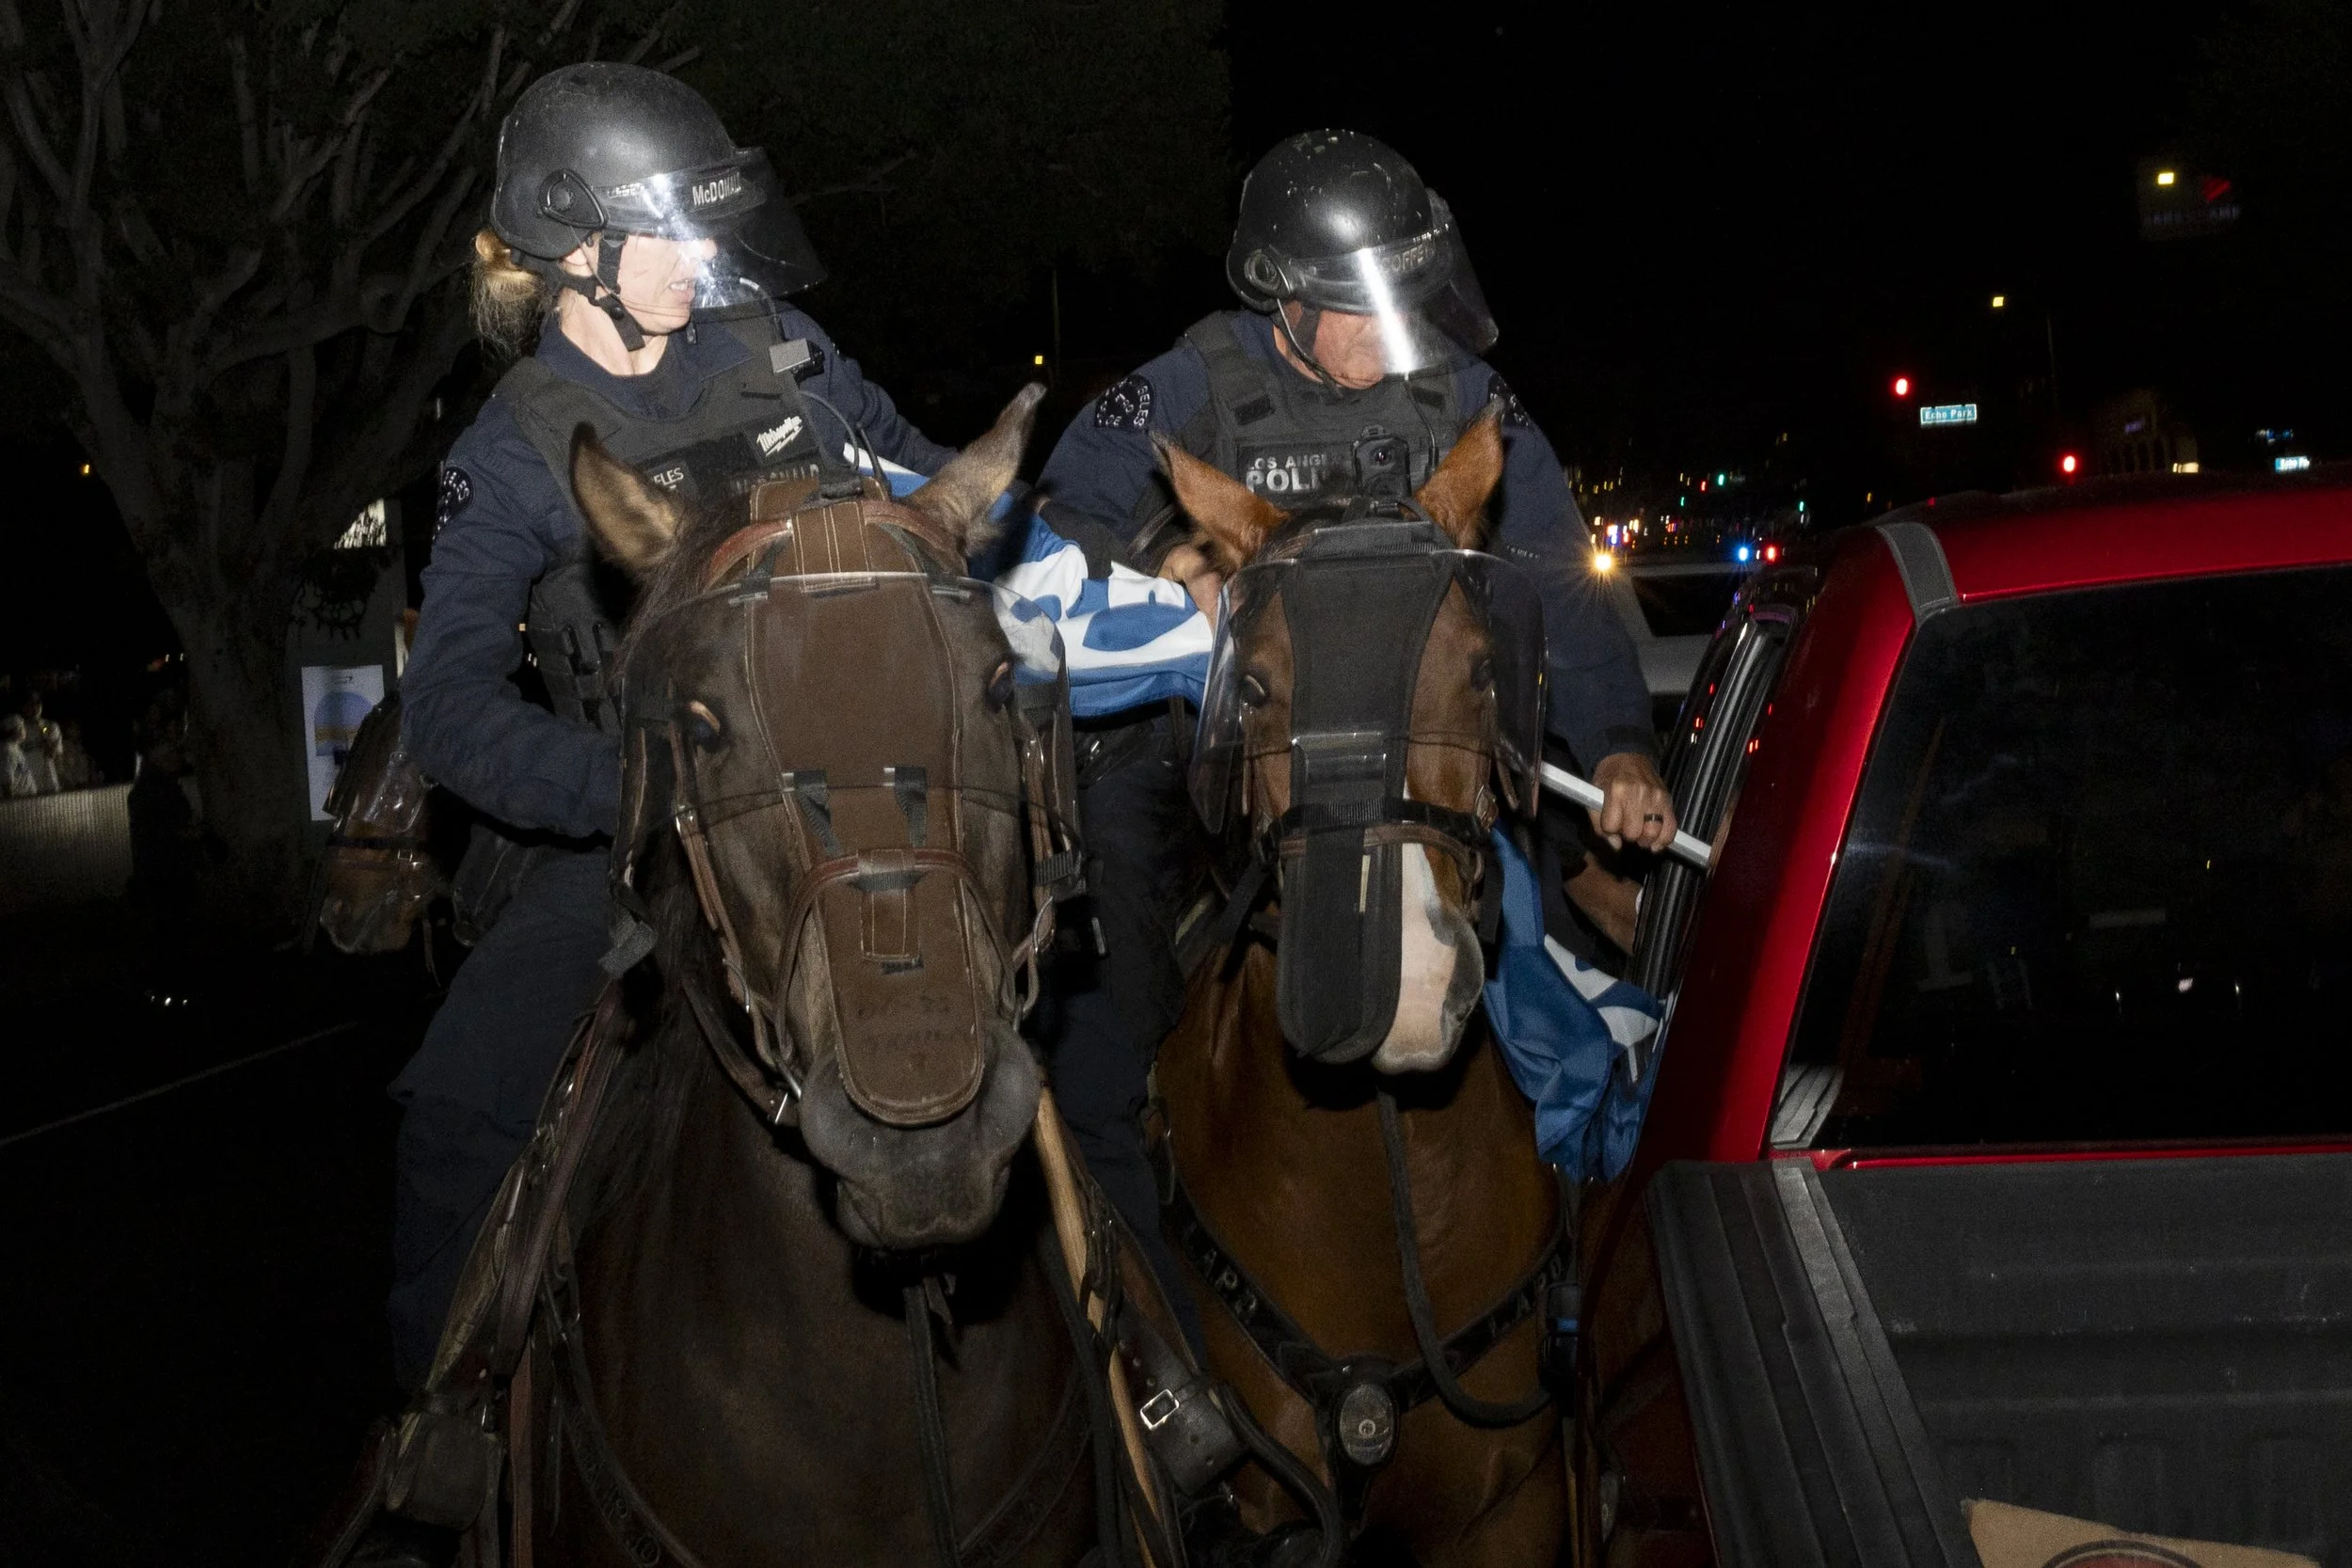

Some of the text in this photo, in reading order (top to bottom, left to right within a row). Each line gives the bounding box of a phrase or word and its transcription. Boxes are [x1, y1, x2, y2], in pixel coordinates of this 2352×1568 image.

[1925, 408, 1973, 420] Echo Park
[1252, 457, 1277, 469] OS
[1246, 468, 1326, 493] POLI
